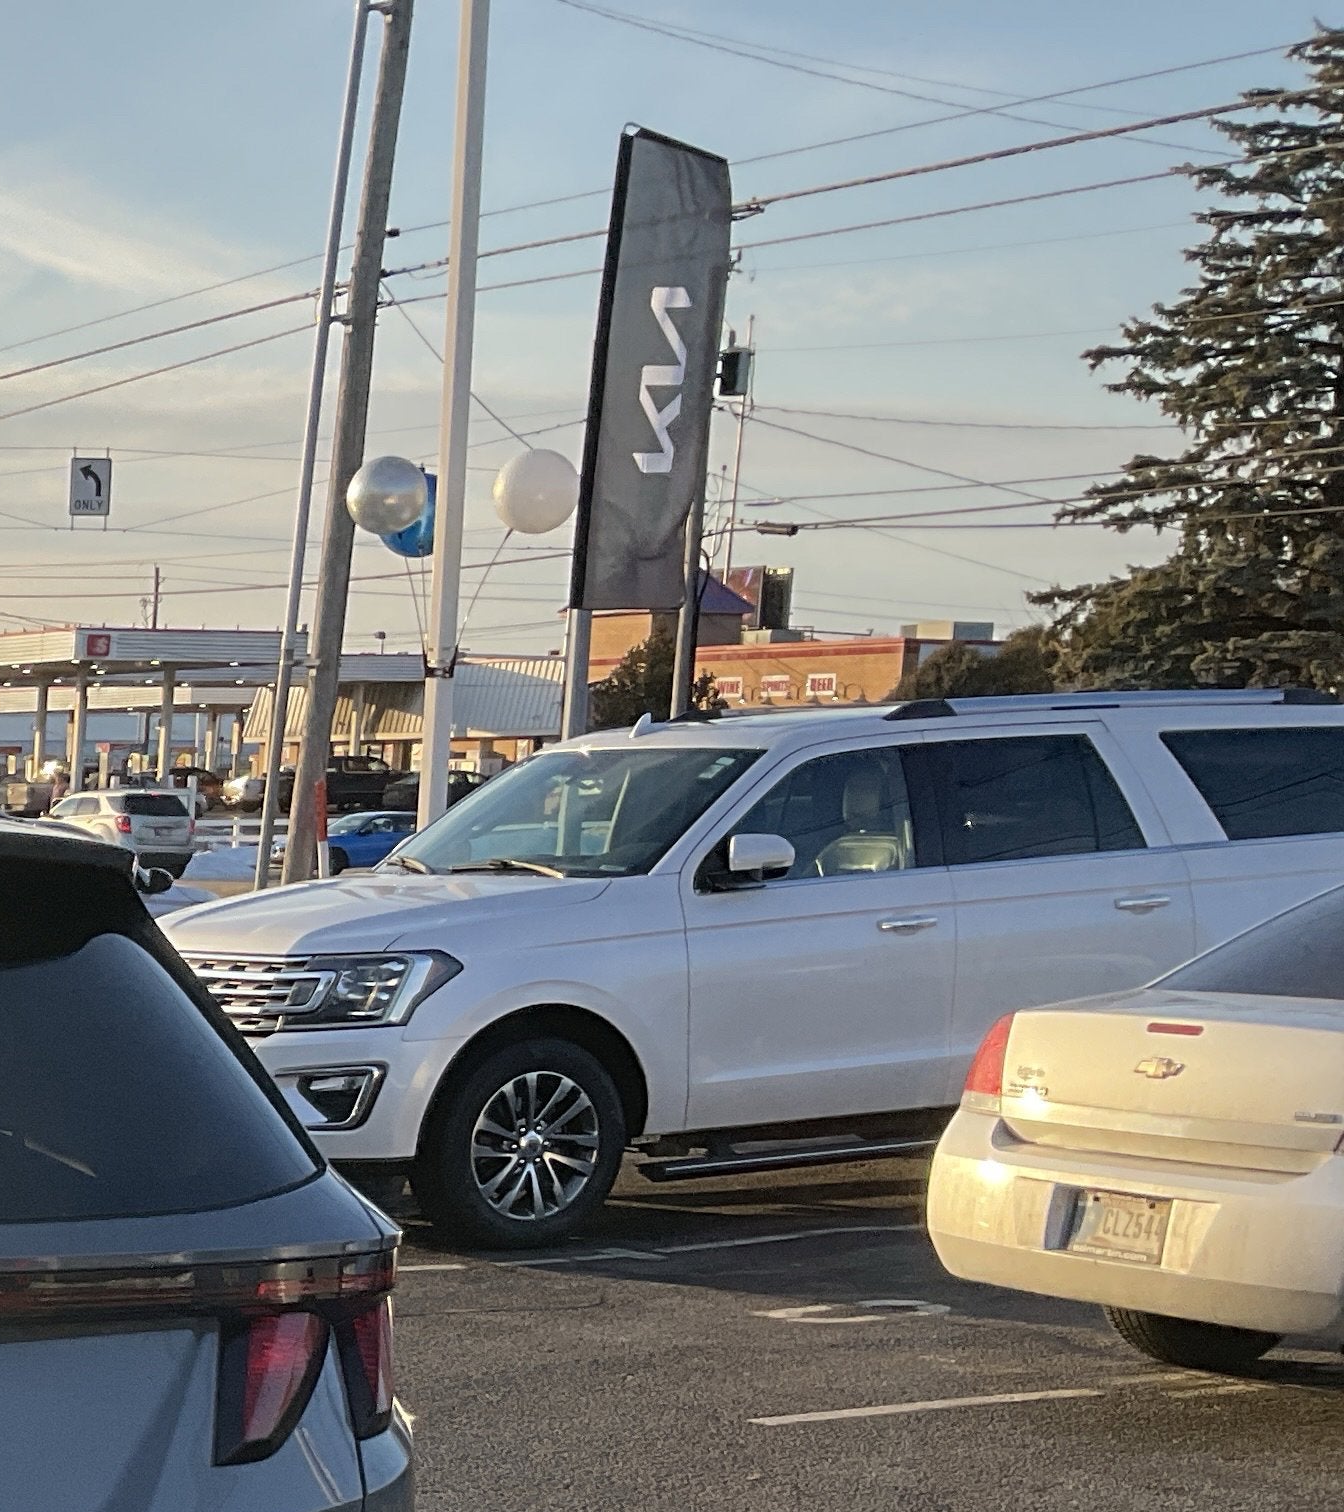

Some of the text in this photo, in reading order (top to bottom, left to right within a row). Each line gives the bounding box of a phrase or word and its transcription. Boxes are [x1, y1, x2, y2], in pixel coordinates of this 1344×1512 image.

[74, 499, 104, 511] ONLY
[716, 681, 740, 695] WINE
[810, 677, 833, 692] BEER
